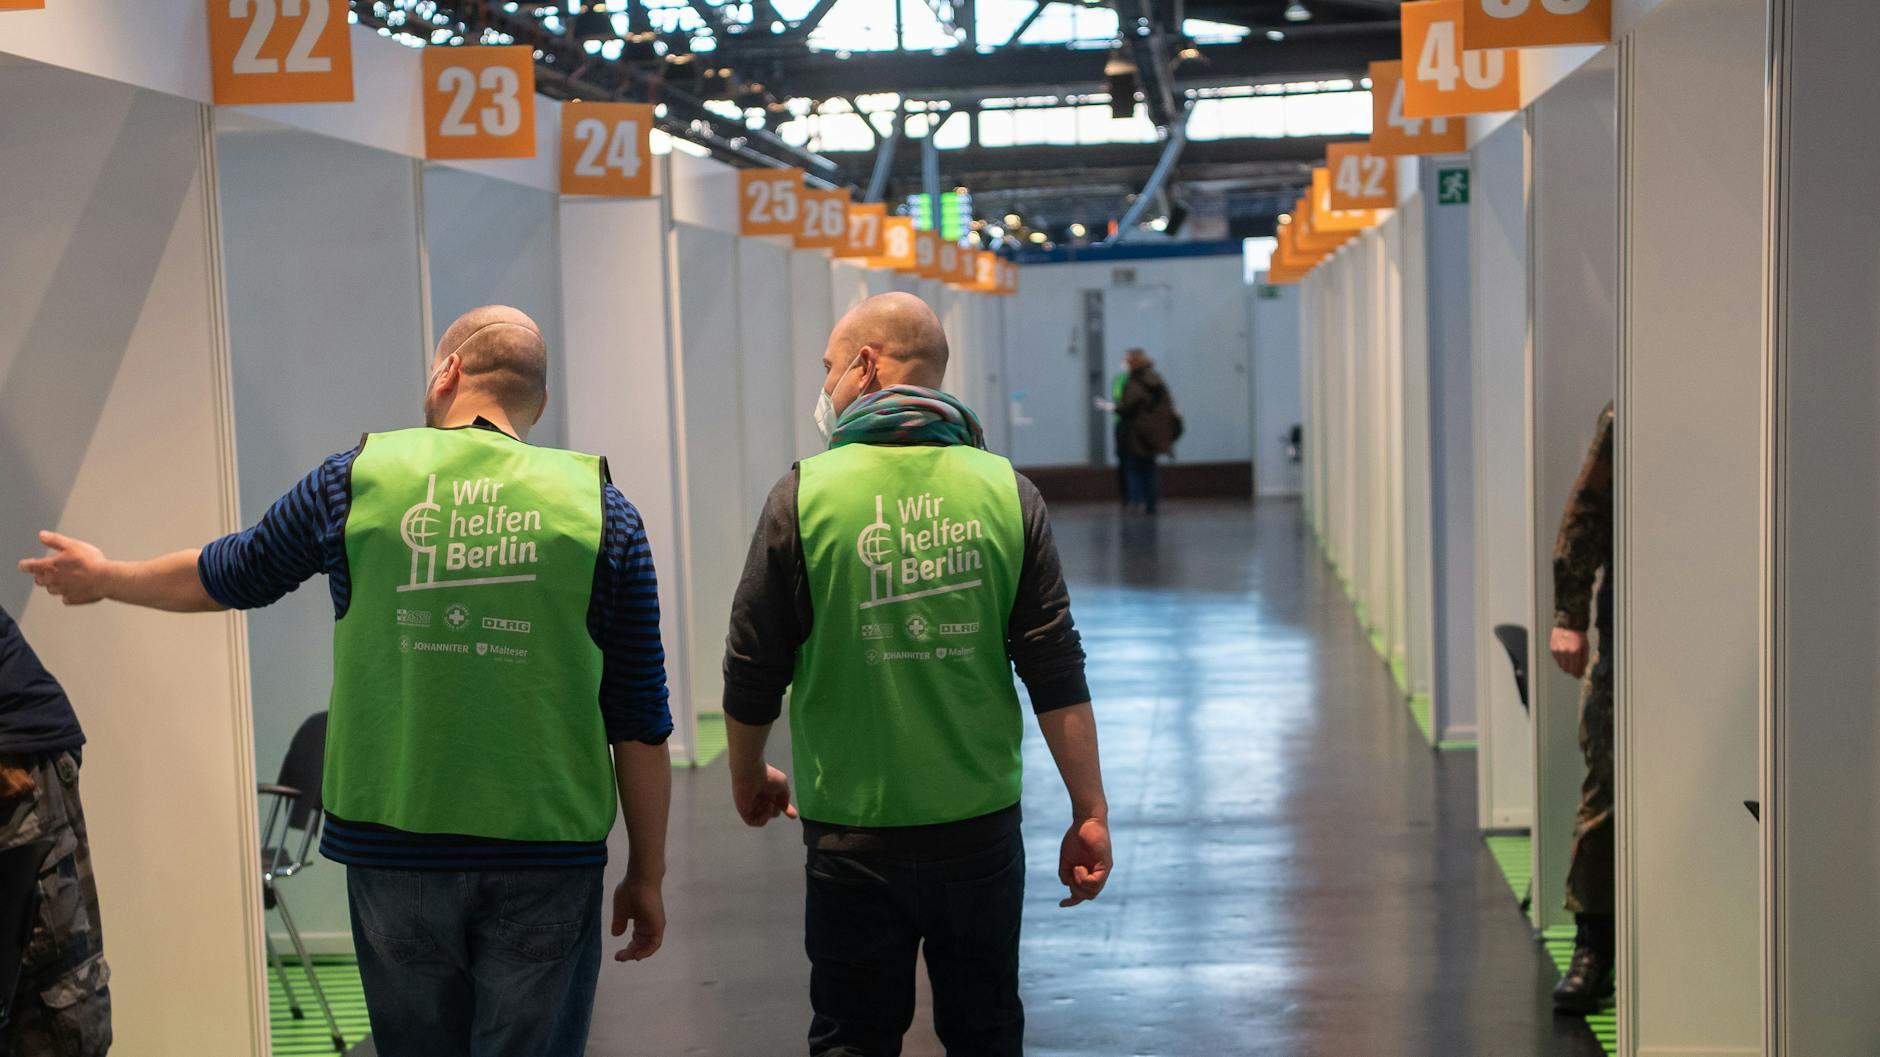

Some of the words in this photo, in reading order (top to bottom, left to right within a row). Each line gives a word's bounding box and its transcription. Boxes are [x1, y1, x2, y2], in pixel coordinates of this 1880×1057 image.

[229, 0, 332, 75] 22
[438, 66, 522, 137] 23
[574, 118, 641, 178] 24
[1335, 155, 1387, 198] 42
[747, 180, 798, 224] 25
[804, 198, 845, 237] 26
[452, 477, 504, 506] Wir
[897, 492, 944, 525] Wir
[449, 506, 541, 538] helfen
[901, 518, 982, 554] helfen
[446, 536, 538, 571] Berlin
[901, 546, 982, 585] Berlin
[413, 641, 469, 654] JOHANNITER
[490, 643, 528, 657] Malteser
